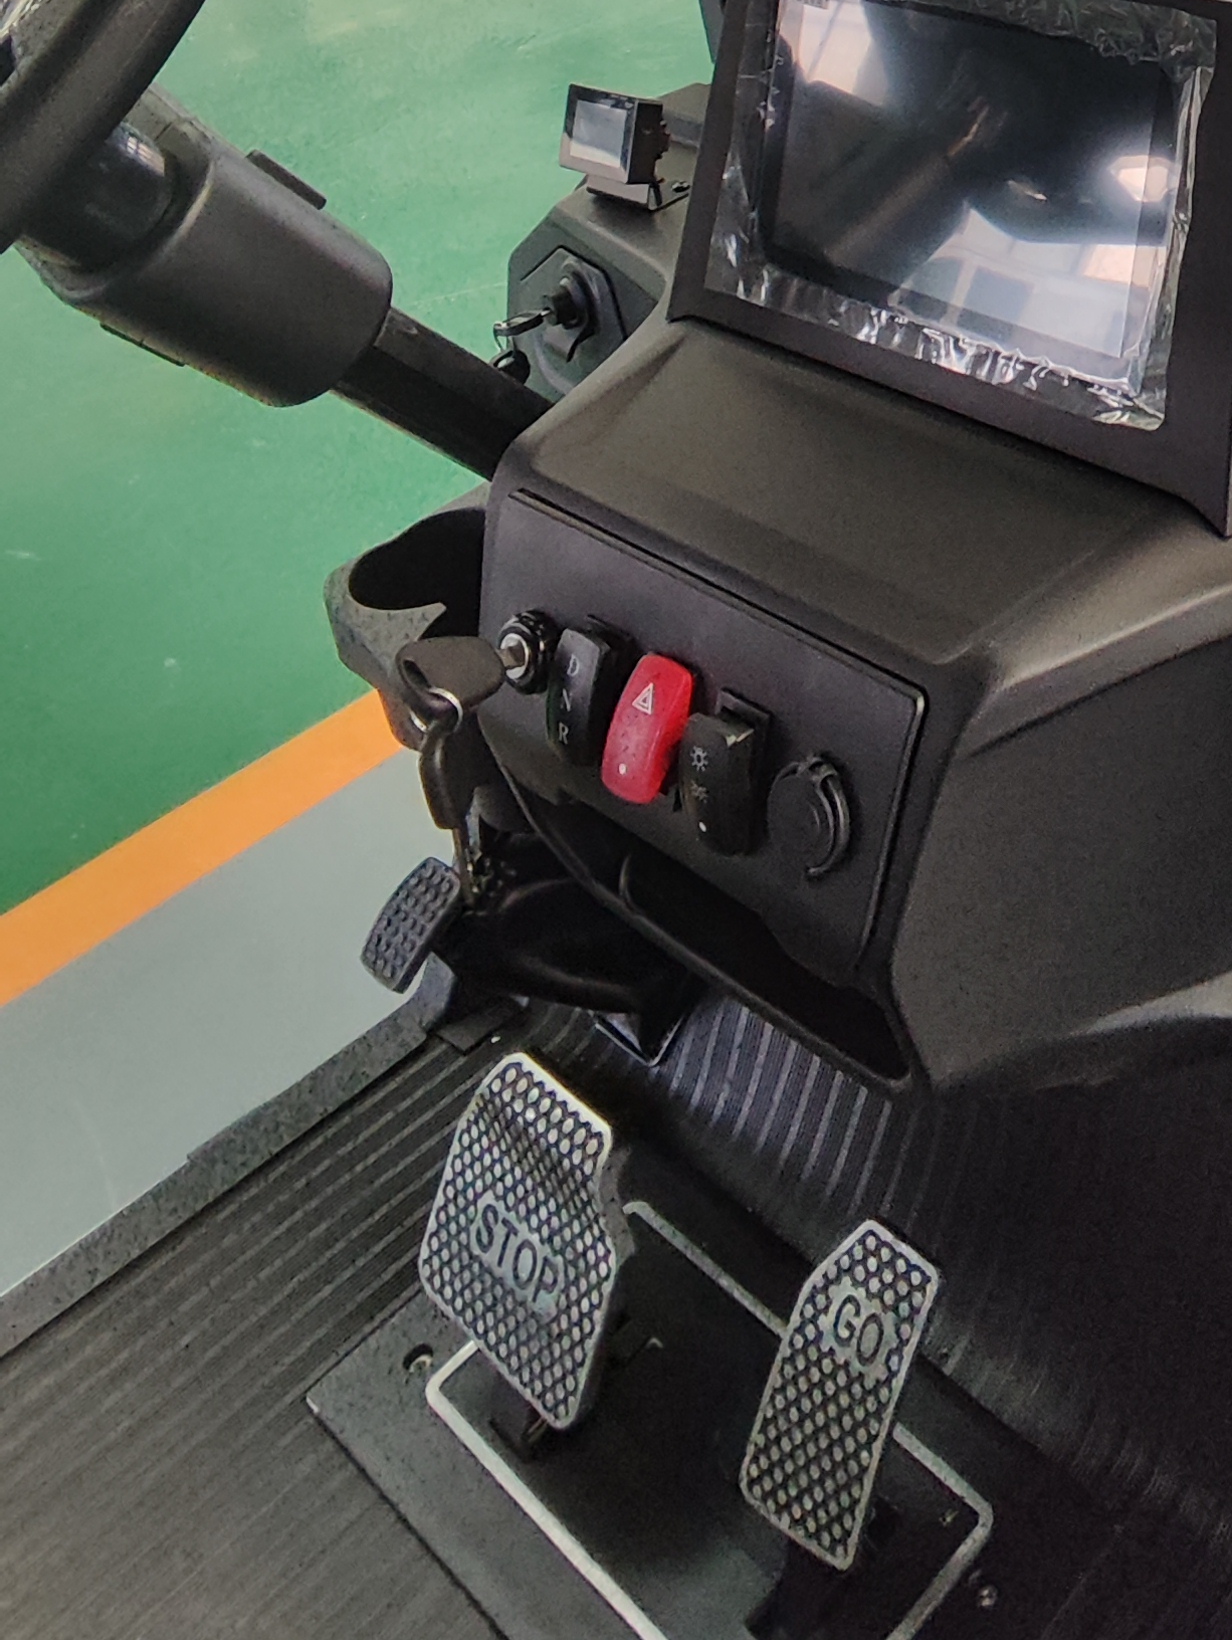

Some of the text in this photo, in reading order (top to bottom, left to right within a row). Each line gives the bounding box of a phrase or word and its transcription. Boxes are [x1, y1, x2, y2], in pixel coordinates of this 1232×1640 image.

[566, 653, 580, 677] D
[560, 688, 573, 712] N
[558, 721, 569, 745] R
[475, 1203, 559, 1303] STOP
[833, 1294, 885, 1367] GO
